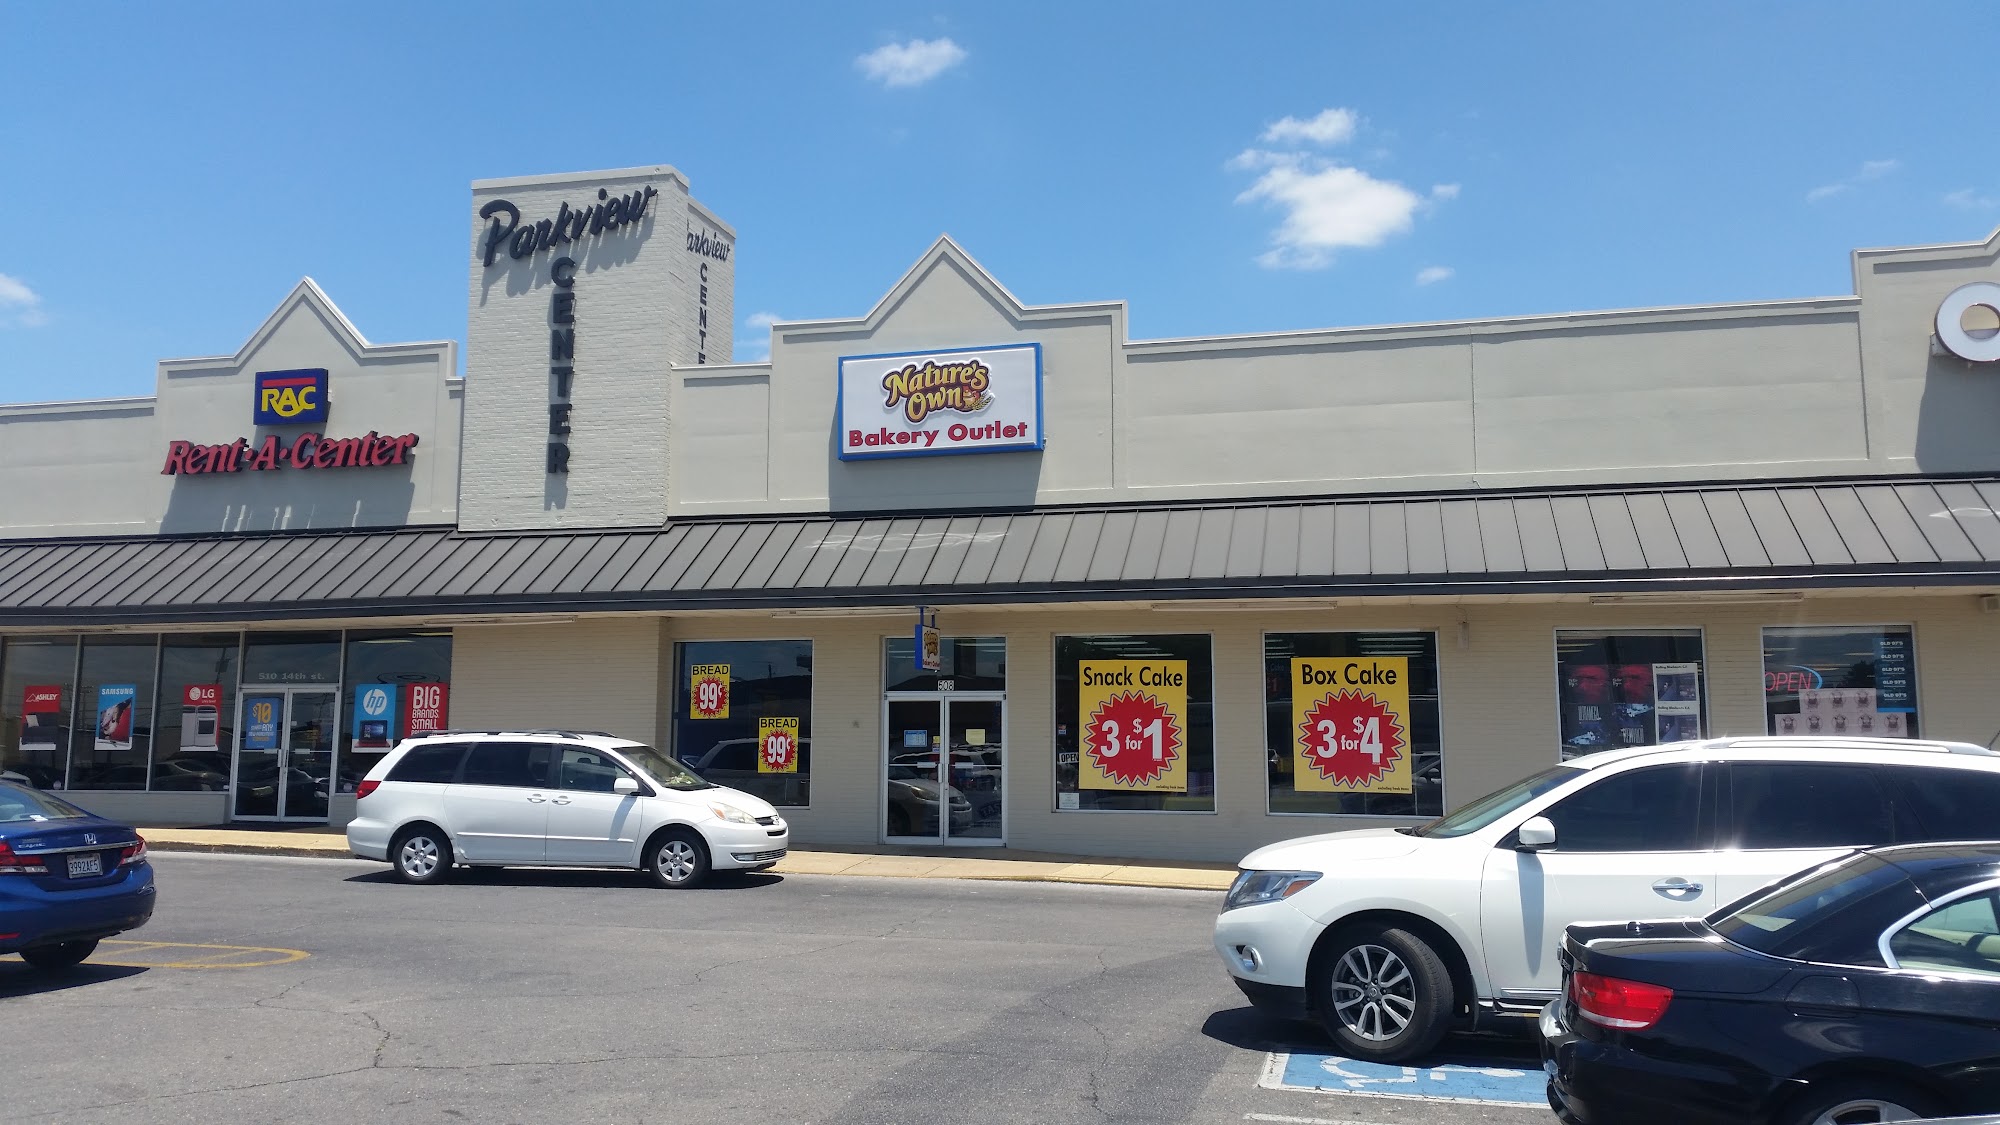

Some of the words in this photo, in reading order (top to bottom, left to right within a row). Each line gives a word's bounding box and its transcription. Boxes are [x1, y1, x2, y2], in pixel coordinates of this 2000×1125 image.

[479, 185, 658, 267] Parkview
[687, 218, 730, 261] arkview
[698, 262, 708, 364] CENTE
[547, 257, 576, 473] CENTER
[884, 362, 989, 407] Nature's
[261, 386, 316, 417] RAC
[907, 386, 962, 420] Own
[849, 427, 939, 447] Bakery
[947, 421, 1028, 441] Outlet
[258, 672, 278, 680] 510
[281, 672, 306, 680] 14th
[692, 665, 729, 676] BREAD
[1083, 665, 1133, 687] Snack
[1139, 666, 1183, 687] Cake
[1301, 663, 1338, 685] Box
[1344, 662, 1397, 685] Cake
[1764, 672, 1812, 691] OPEN
[35, 693, 59, 701] ASHLEY
[201, 688, 215, 698] LG
[938, 680, 954, 691] 508
[364, 689, 387, 715] hp
[413, 686, 440, 709] BIG
[252, 703, 272, 723] $10
[411, 719, 438, 729] SMALL
[760, 718, 798, 728] BREAD
[261, 723, 274, 732] ANY
[1100, 720, 1121, 758] 3
[1316, 719, 1338, 759] 3
[1341, 734, 1360, 750] for
[1353, 715, 1383, 763] $4
[1125, 735, 1143, 750] for
[1133, 718, 1163, 761] $1
[1060, 753, 1078, 763] OPEN
